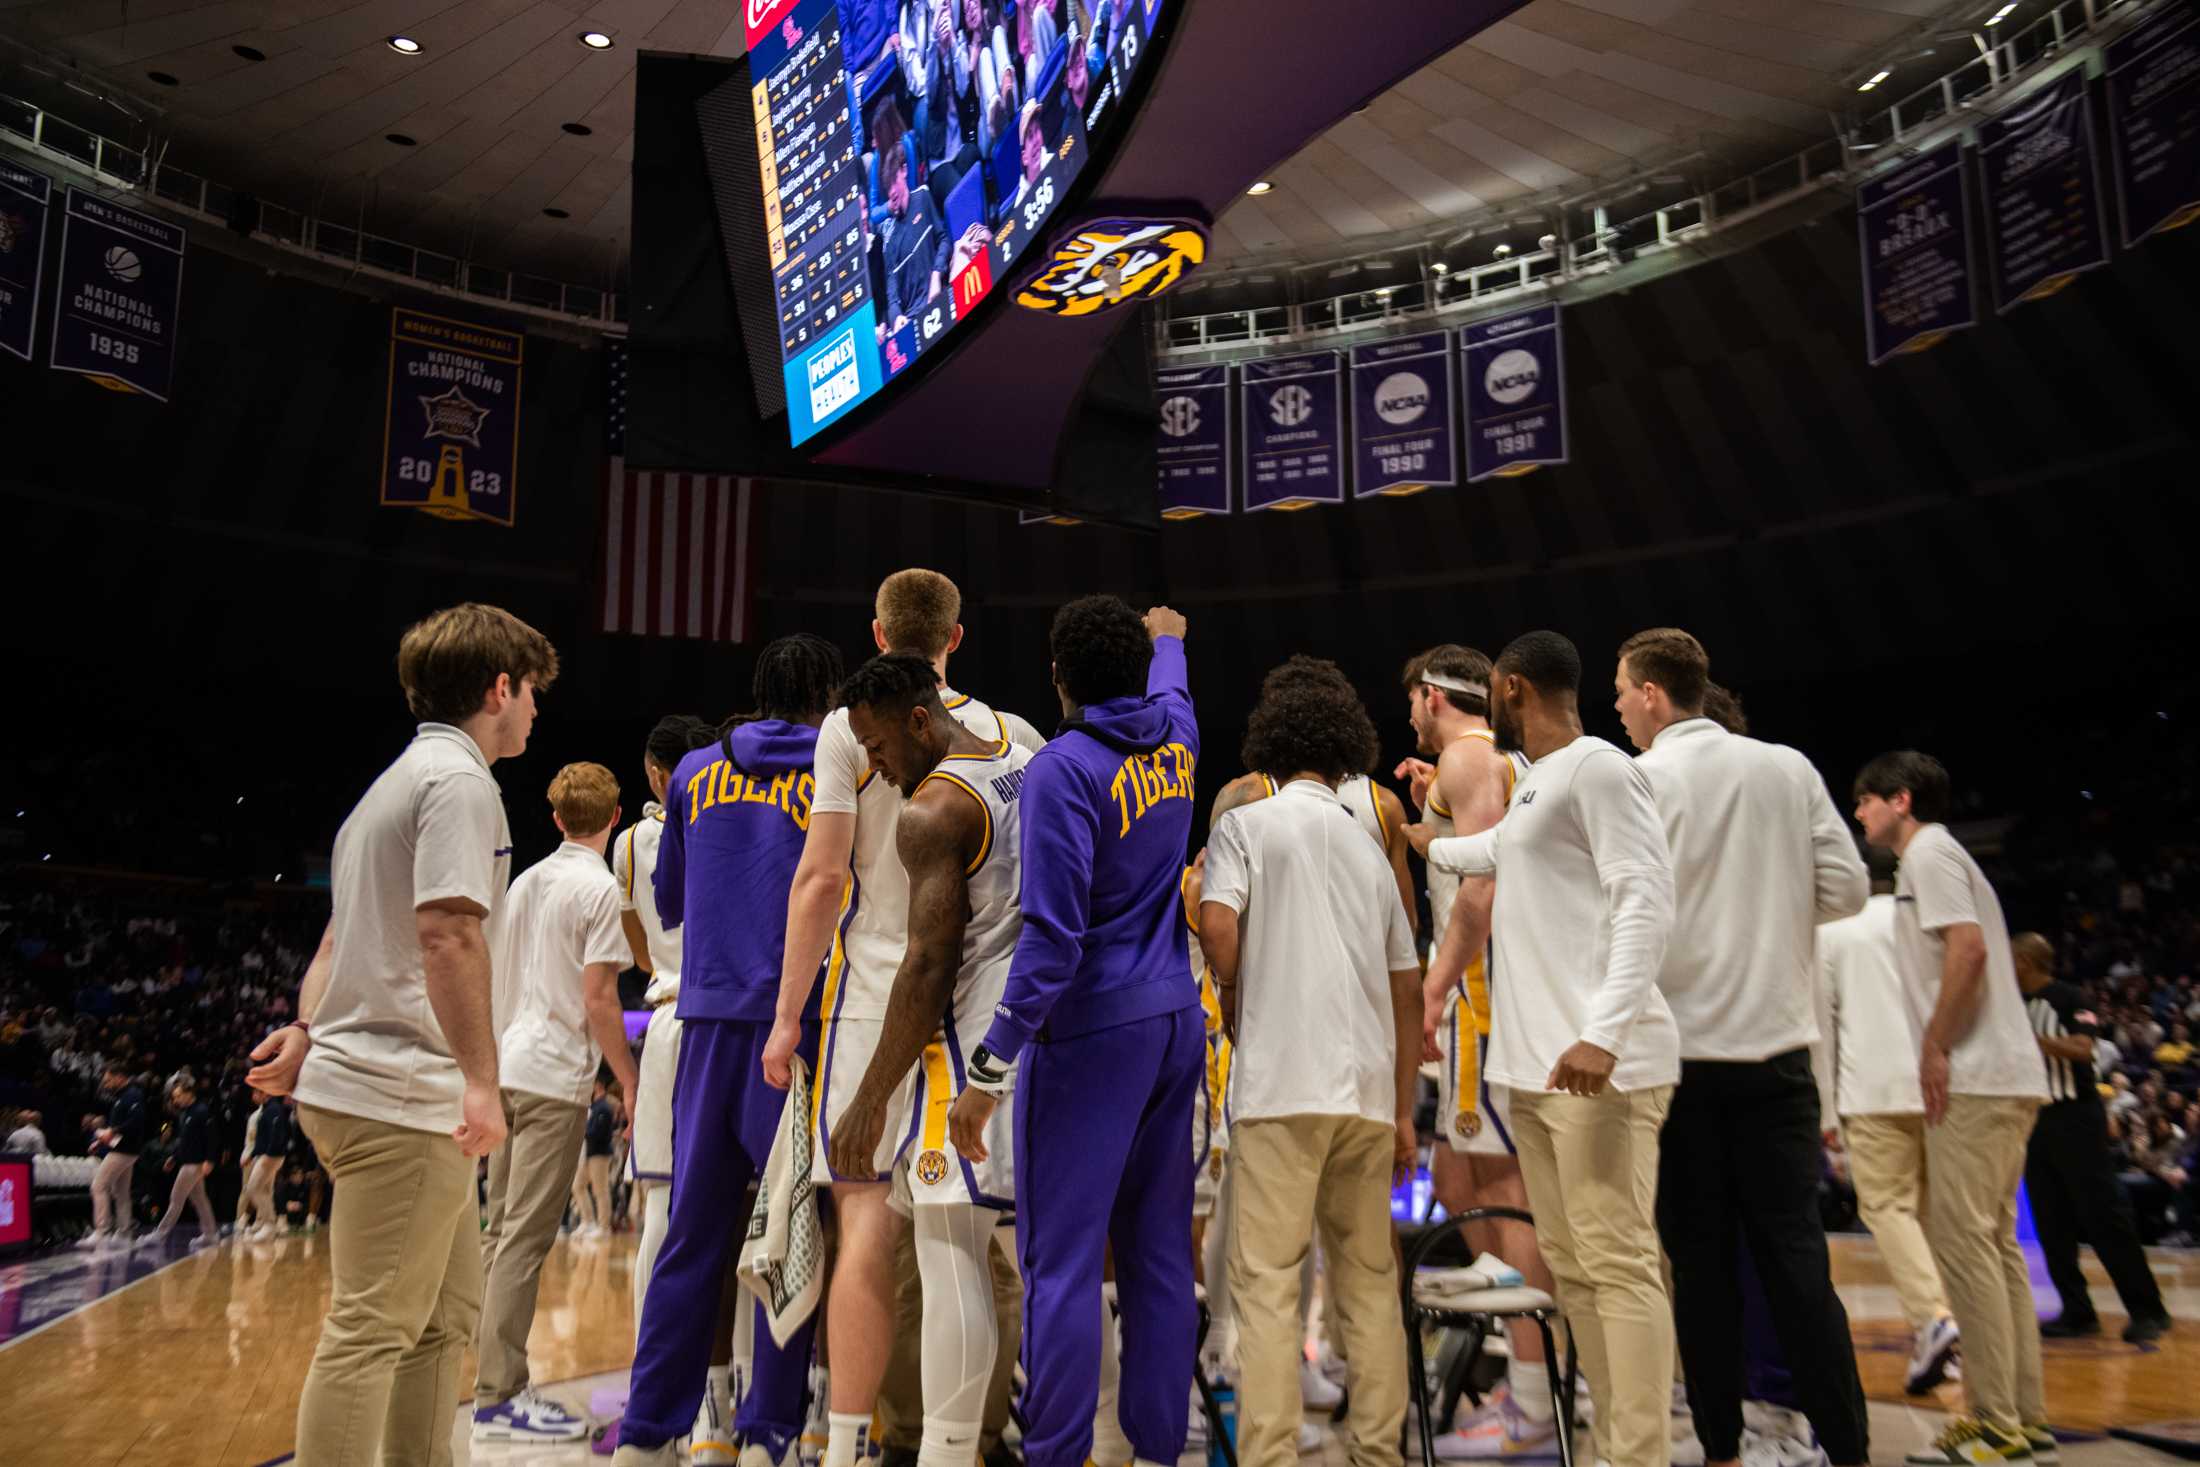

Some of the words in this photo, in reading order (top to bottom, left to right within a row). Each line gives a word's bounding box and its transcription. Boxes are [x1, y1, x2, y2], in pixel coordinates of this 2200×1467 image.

[1024, 176, 1054, 230] 3:56
[818, 213, 826, 228] 5
[1002, 241, 1012, 262] 2
[83, 283, 154, 318] NATIONAL
[74, 294, 161, 334] CHAMPIONS
[923, 307, 943, 339] 62
[798, 327, 807, 342] 5
[89, 332, 140, 364] 1935
[427, 351, 485, 374] NATIONAL
[407, 361, 504, 395] CHAMPIONS
[1491, 370, 1541, 392] NCAA
[1269, 384, 1313, 426] SEC
[1380, 394, 1429, 413] NCAA
[1159, 396, 1201, 437] SEC
[1483, 424, 1514, 439] FINAL
[1515, 416, 1545, 432] FOUR
[1265, 430, 1319, 444] CHAMPIONS
[1372, 443, 1403, 457] FINAL
[1404, 438, 1434, 454] FOUR
[1495, 431, 1536, 455] 1991
[398, 456, 432, 483] 20
[1381, 453, 1426, 475] 1990
[469, 469, 502, 496] 23
[687, 759, 816, 831] TIGERS
